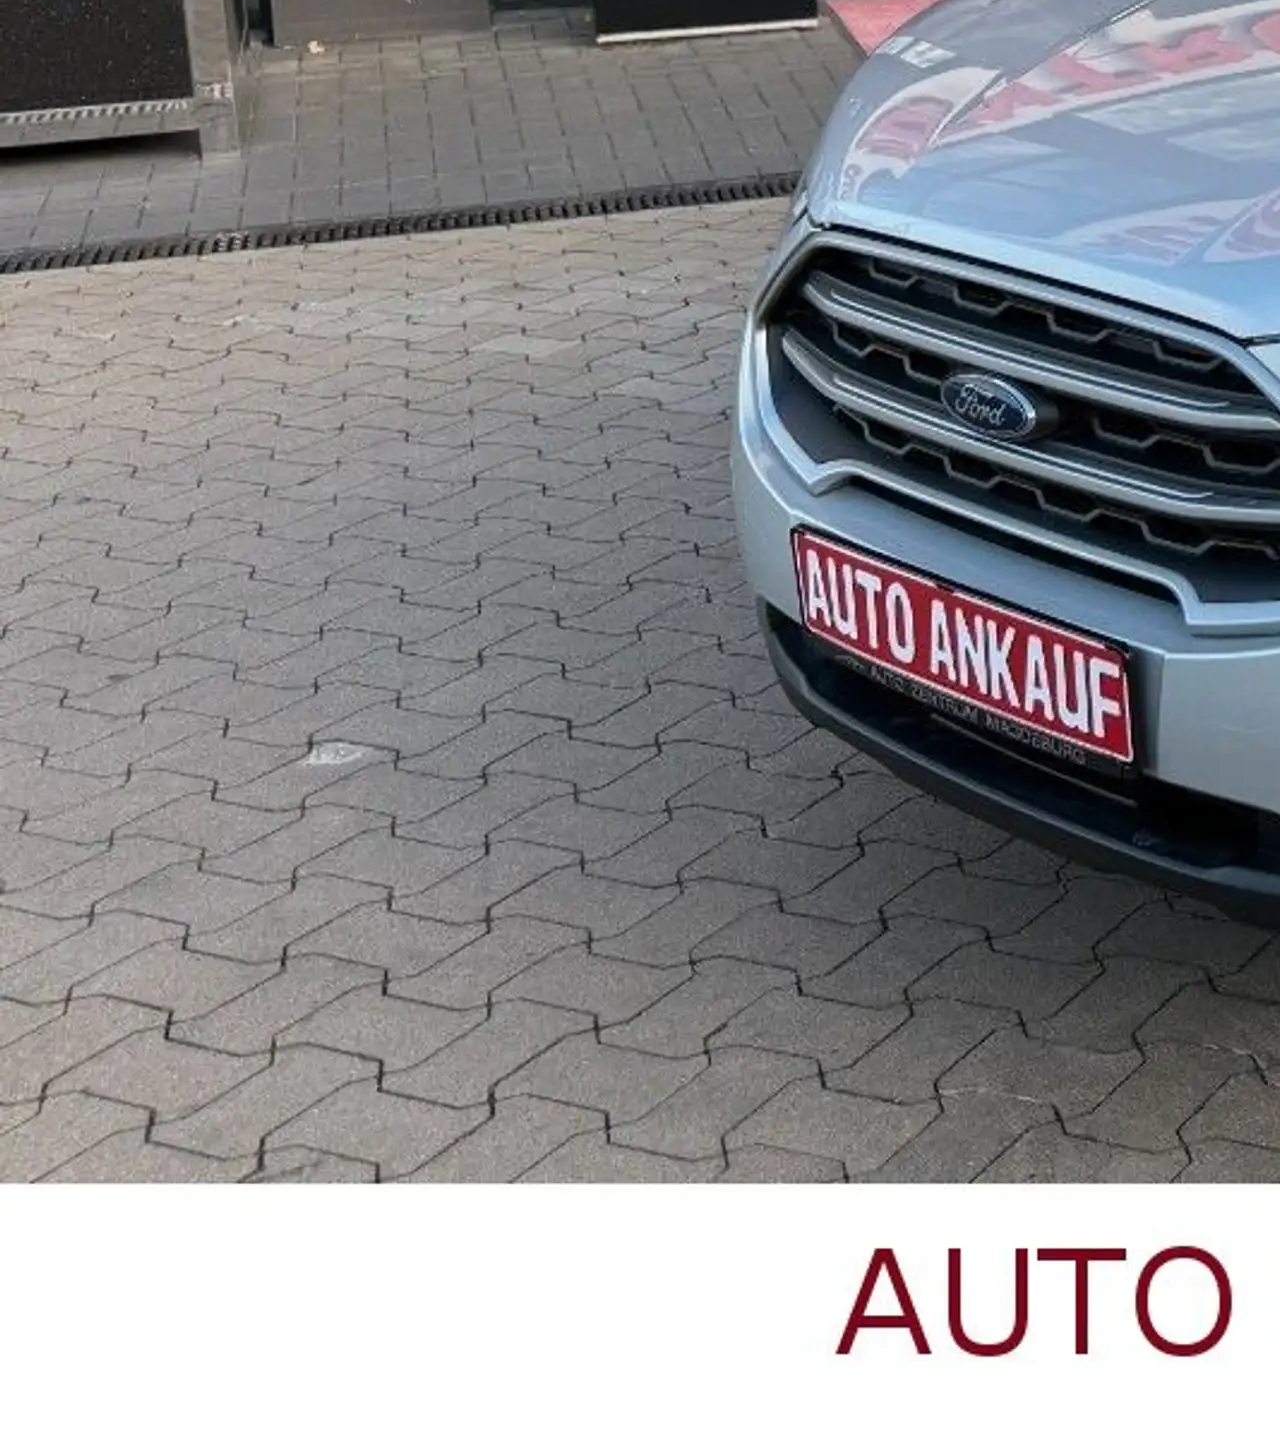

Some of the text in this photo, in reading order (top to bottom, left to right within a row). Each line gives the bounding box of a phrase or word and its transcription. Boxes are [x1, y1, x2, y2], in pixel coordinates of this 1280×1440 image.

[955, 383, 1006, 426] Ford
[805, 548, 1122, 740] AUTO ANKAUF
